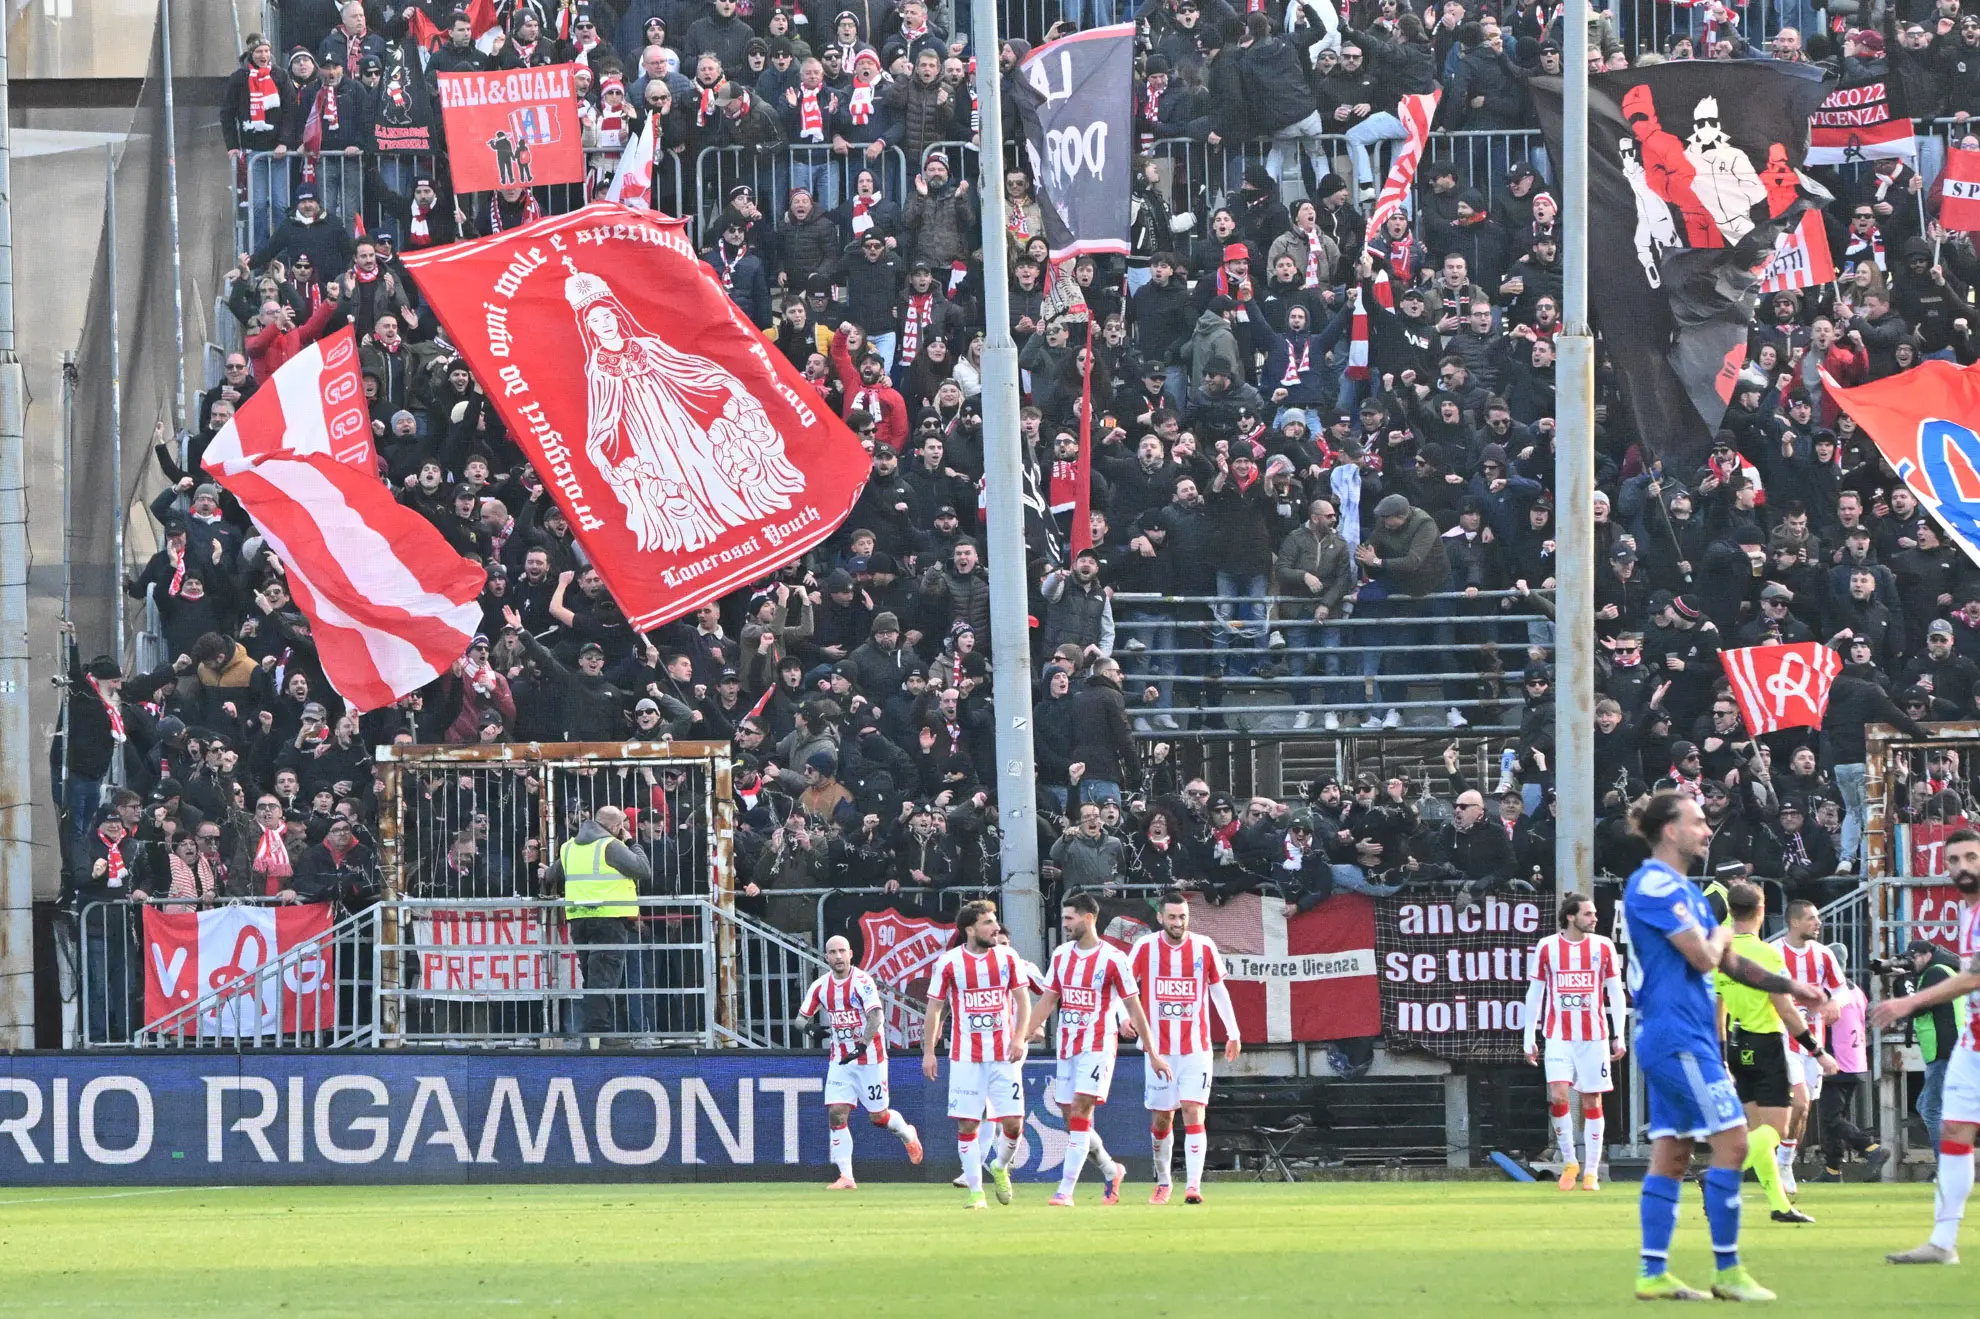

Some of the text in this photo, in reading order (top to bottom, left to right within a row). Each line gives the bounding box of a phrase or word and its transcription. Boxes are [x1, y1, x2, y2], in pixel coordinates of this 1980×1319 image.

[437, 69, 570, 108] TALI&QUALI
[1820, 82, 1886, 108] RCO 22
[493, 246, 548, 300] male
[483, 301, 515, 358] ogni
[499, 363, 530, 398] da
[517, 401, 606, 533] proteggici
[660, 504, 822, 589] Lanerossi Youth
[1399, 895, 1540, 935] anche
[878, 924, 896, 947] 90
[1385, 945, 1537, 984] se tutti
[1557, 972, 1594, 988] DIESEL
[1156, 979, 1195, 997] DIESEL
[829, 1010, 860, 1026] DIESEL
[1398, 995, 1467, 1032] noi
[1090, 1065, 1100, 1082] 4
[1600, 1062, 1608, 1078] 6
[867, 1084, 883, 1101] 32
[200, 1074, 824, 1165] RIGAMONT
